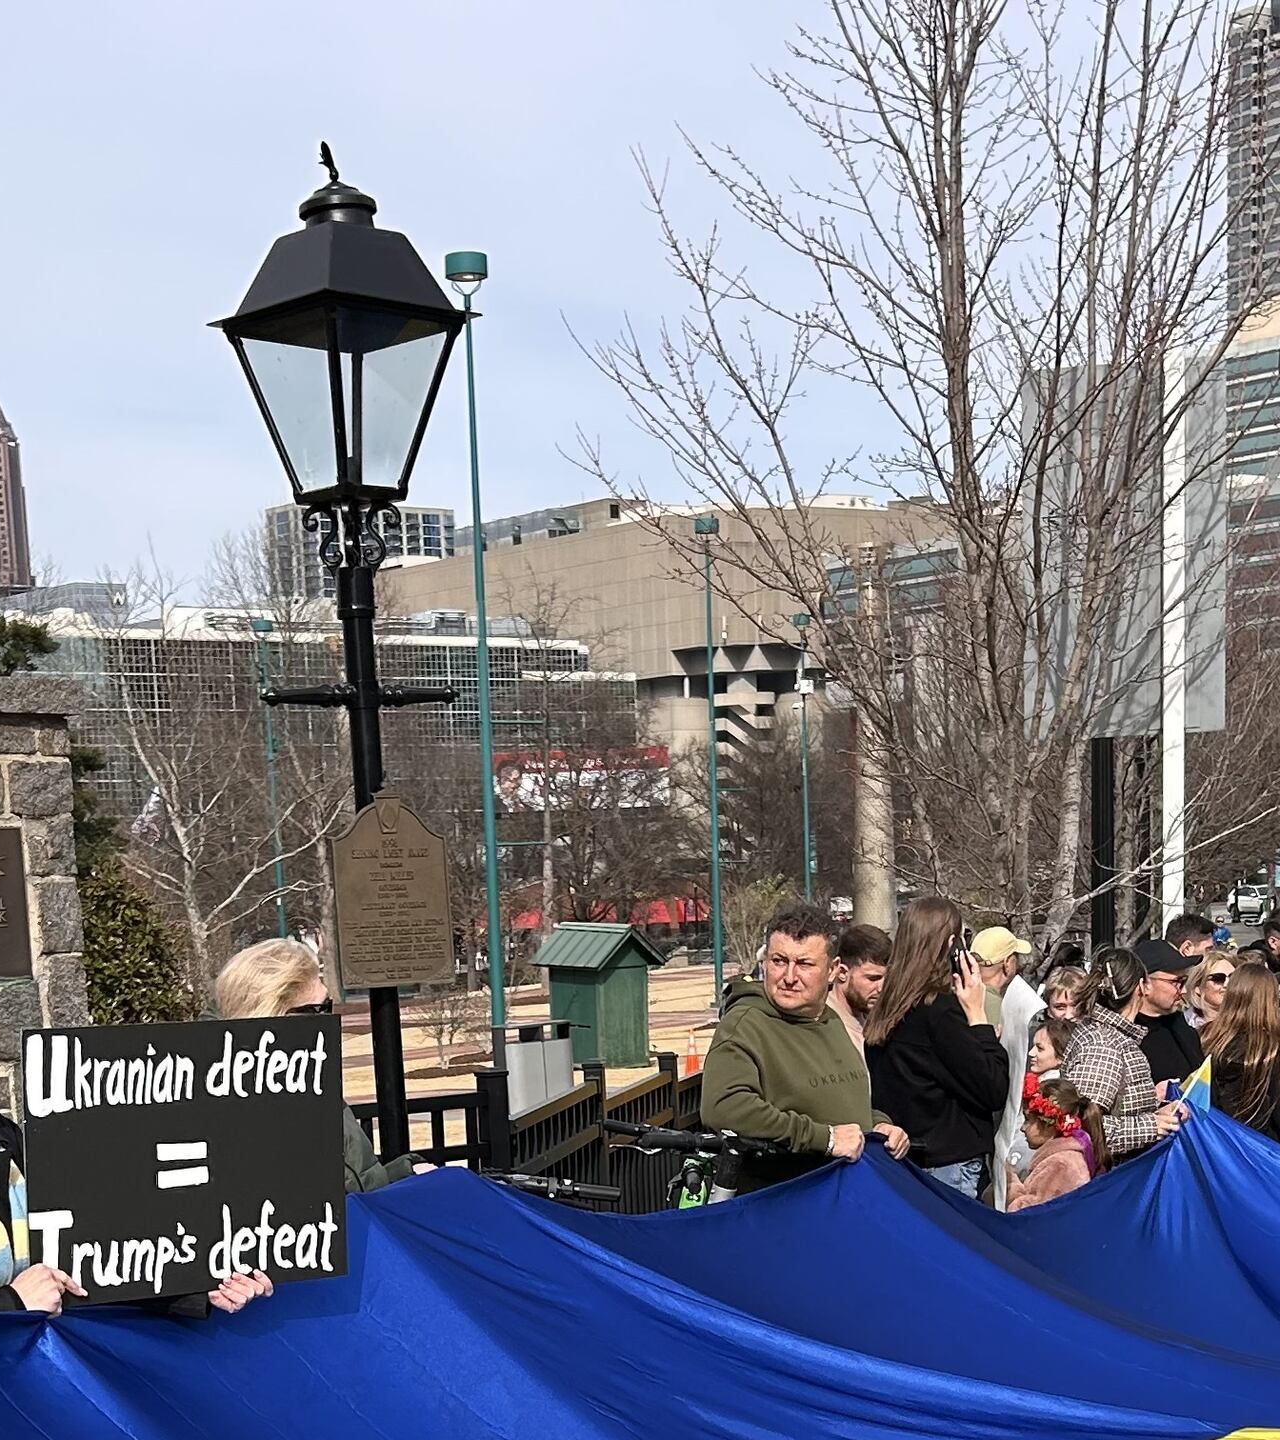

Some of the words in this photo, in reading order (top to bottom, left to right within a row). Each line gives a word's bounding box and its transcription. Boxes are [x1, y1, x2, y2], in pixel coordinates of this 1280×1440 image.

[25, 1032, 196, 1118] Ukranian
[205, 1029, 328, 1098] defeat
[155, 1140, 210, 1190] =
[27, 1209, 198, 1295] Trump's
[208, 1199, 340, 1280] defeat
